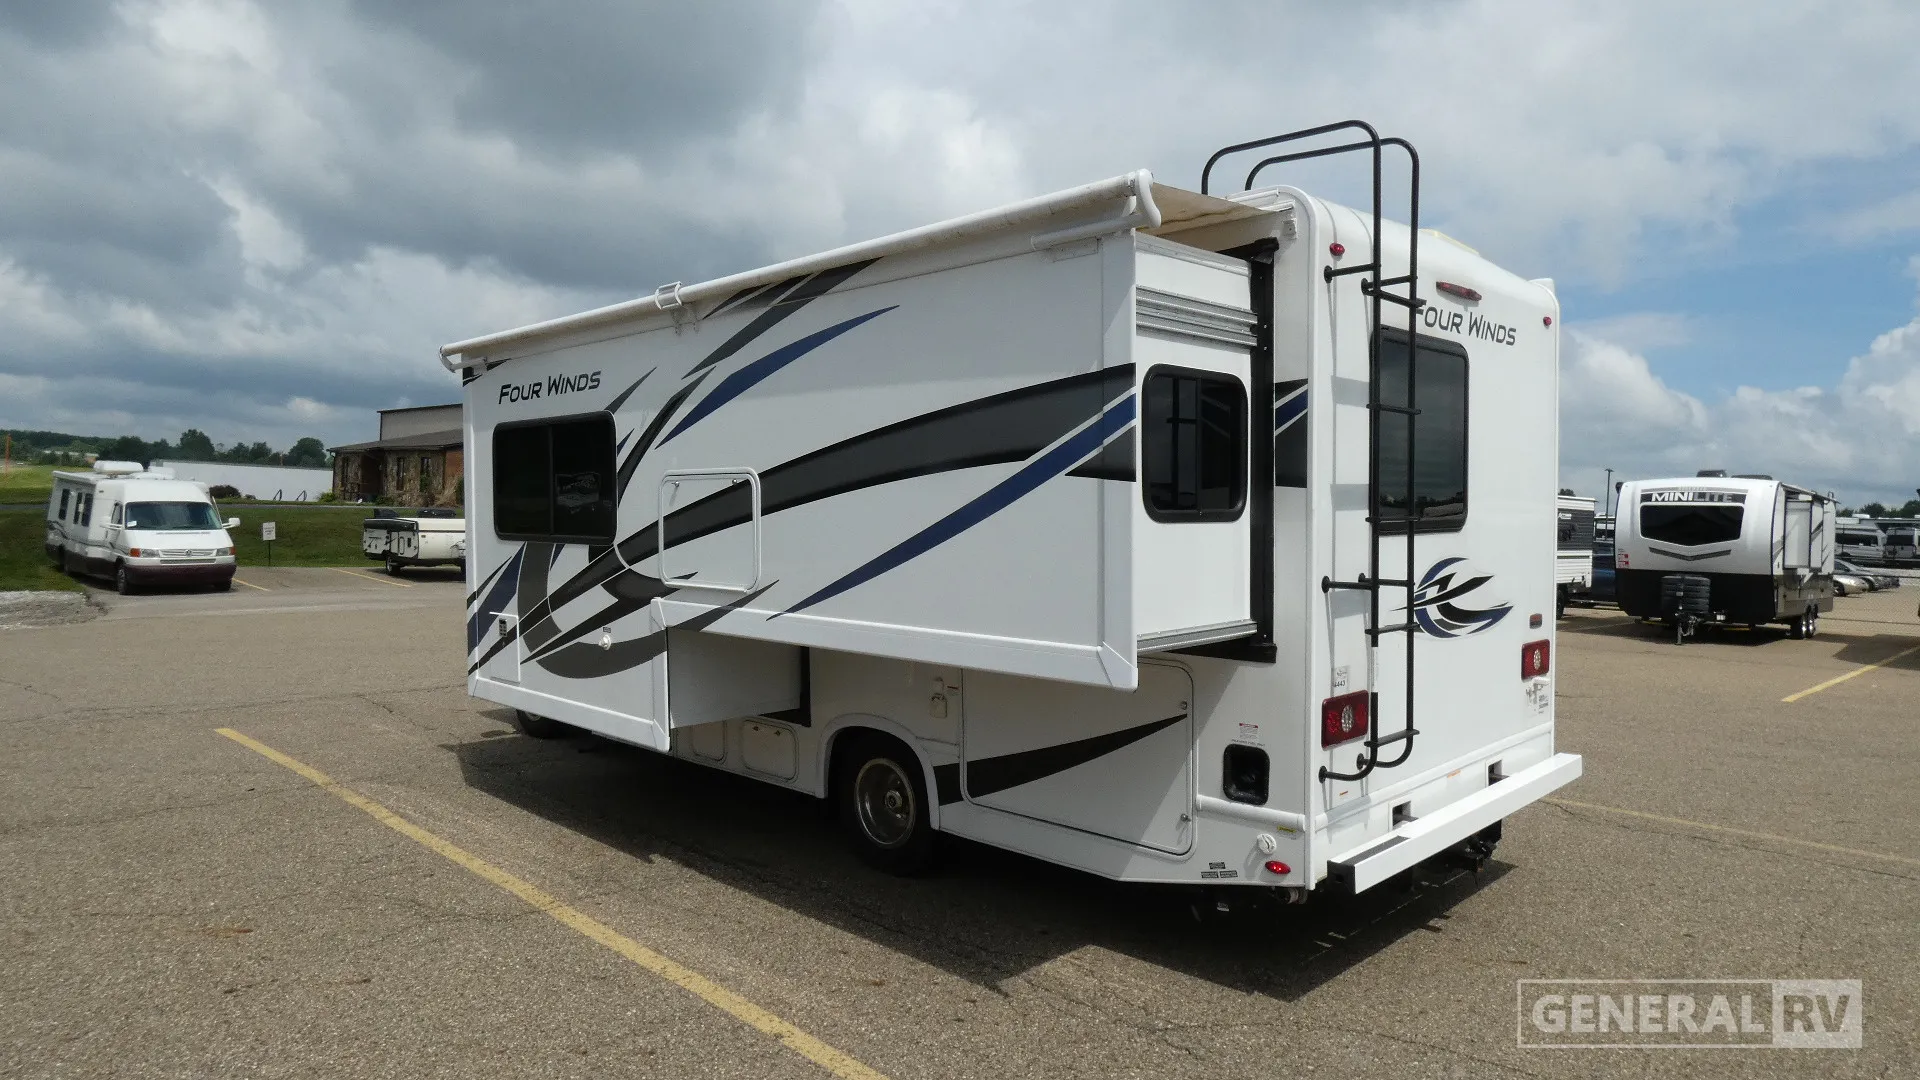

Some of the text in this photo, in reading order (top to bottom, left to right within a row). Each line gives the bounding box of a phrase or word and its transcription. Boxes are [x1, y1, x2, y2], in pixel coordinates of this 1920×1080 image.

[1468, 312, 1517, 346] WINDS
[499, 371, 602, 404] FOUR WINDS
